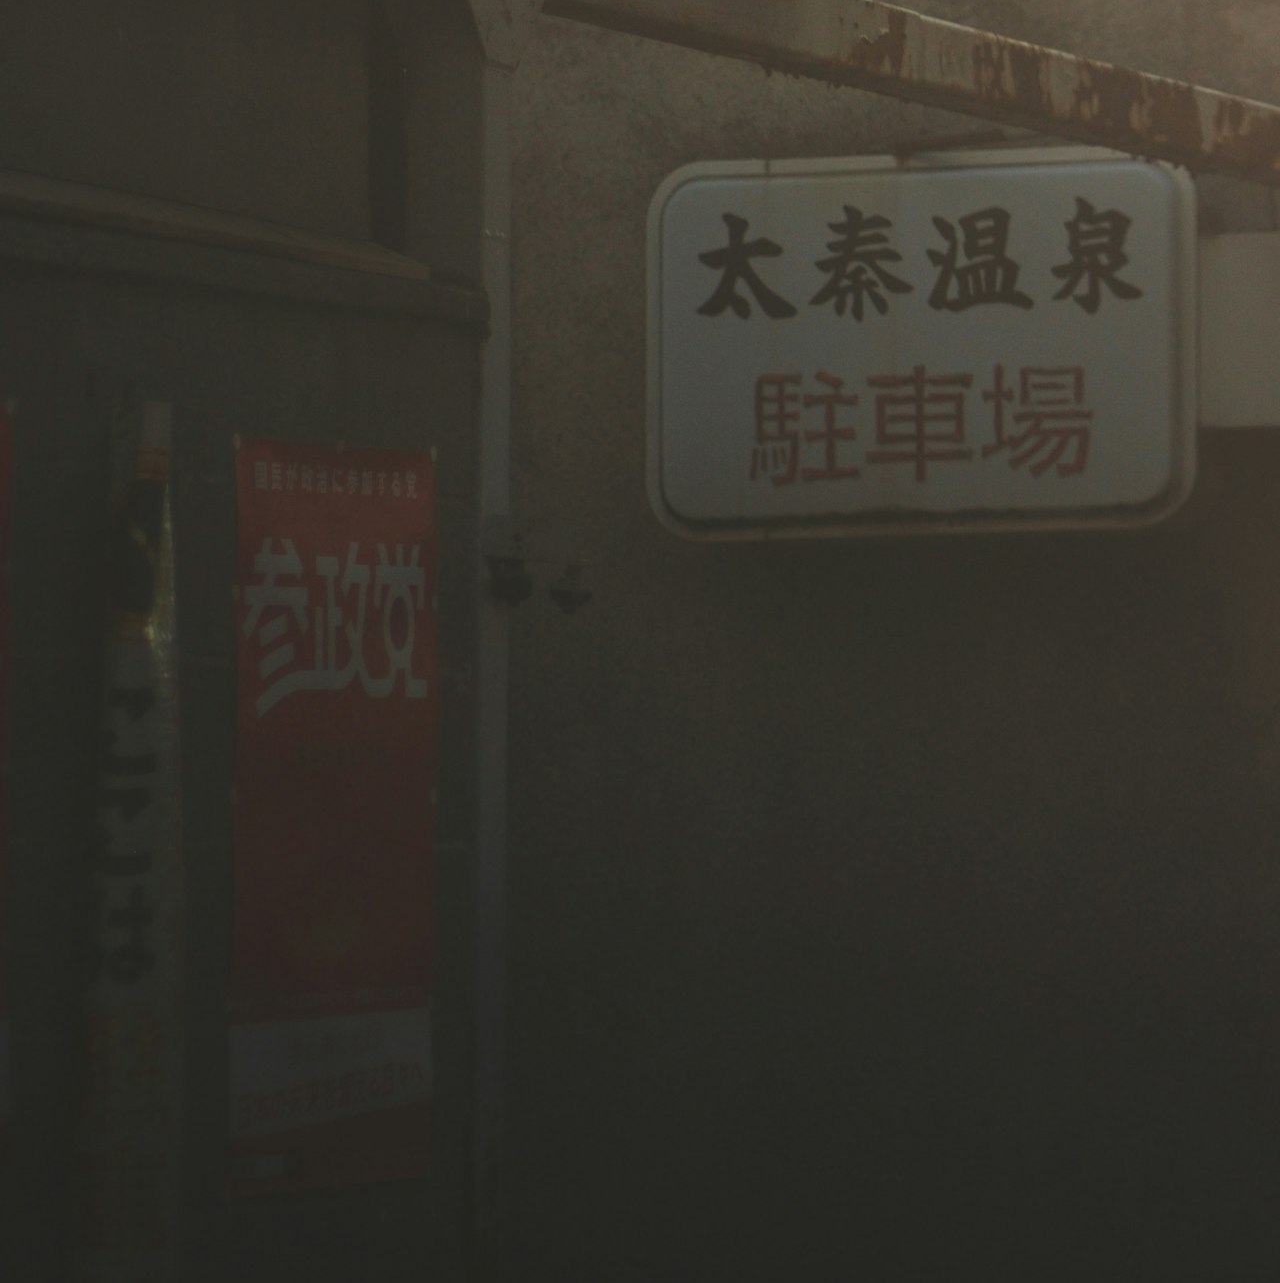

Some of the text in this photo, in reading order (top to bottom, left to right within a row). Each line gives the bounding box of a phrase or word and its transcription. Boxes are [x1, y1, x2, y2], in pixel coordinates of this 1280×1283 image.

[696, 196, 1144, 322] 太秦温泉
[749, 364, 1095, 487] 駐車場
[242, 537, 429, 719] 参政党
